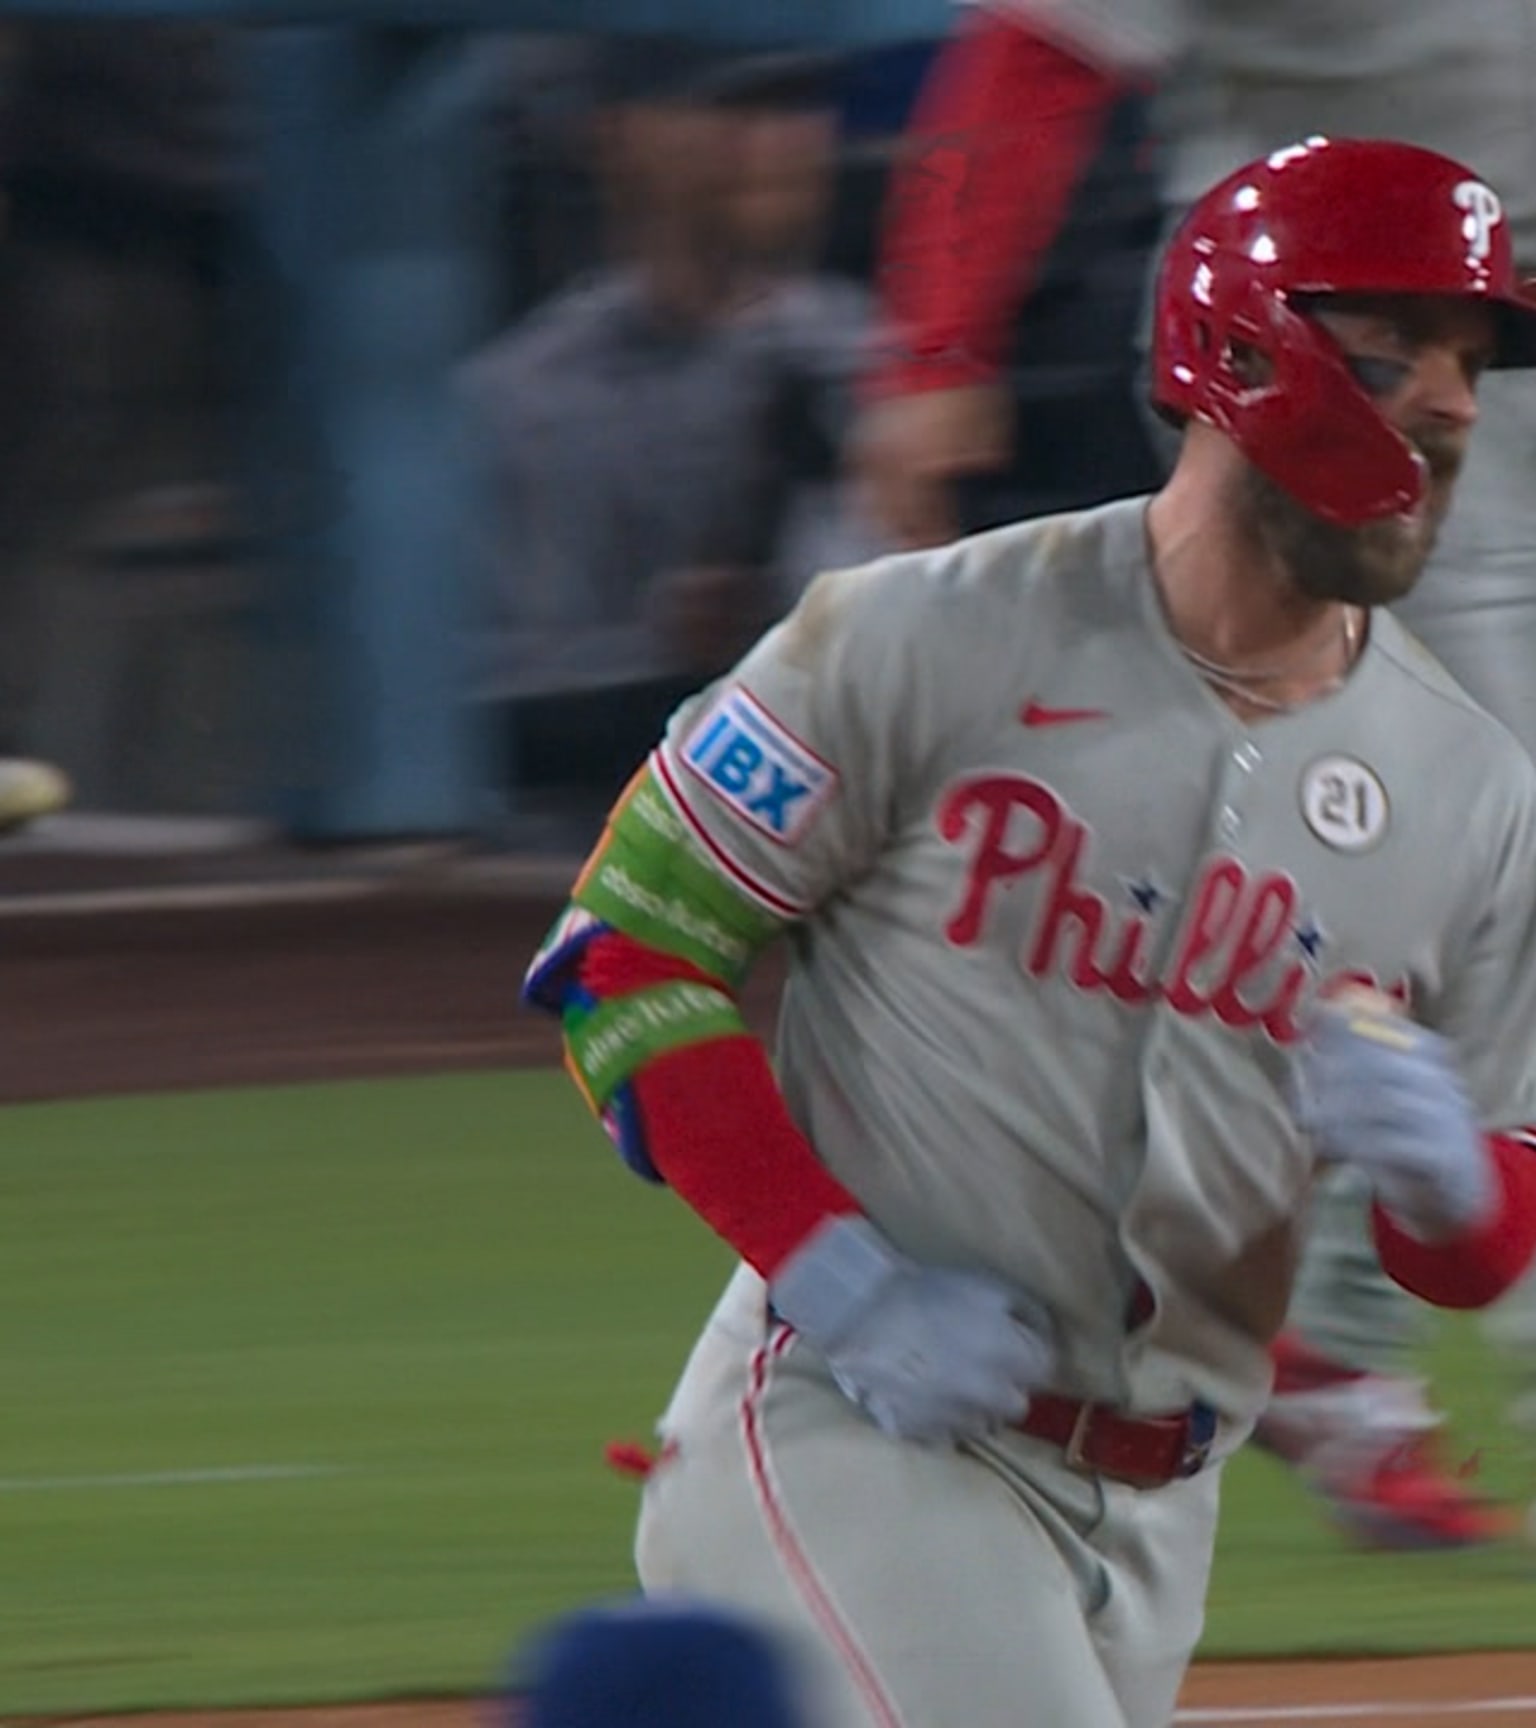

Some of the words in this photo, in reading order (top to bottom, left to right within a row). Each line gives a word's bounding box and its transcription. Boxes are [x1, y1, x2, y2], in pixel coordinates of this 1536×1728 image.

[1453, 181, 1501, 259] P
[689, 713, 811, 834] IBX
[1318, 776, 1368, 832] 21
[937, 771, 1410, 1046] Philli
